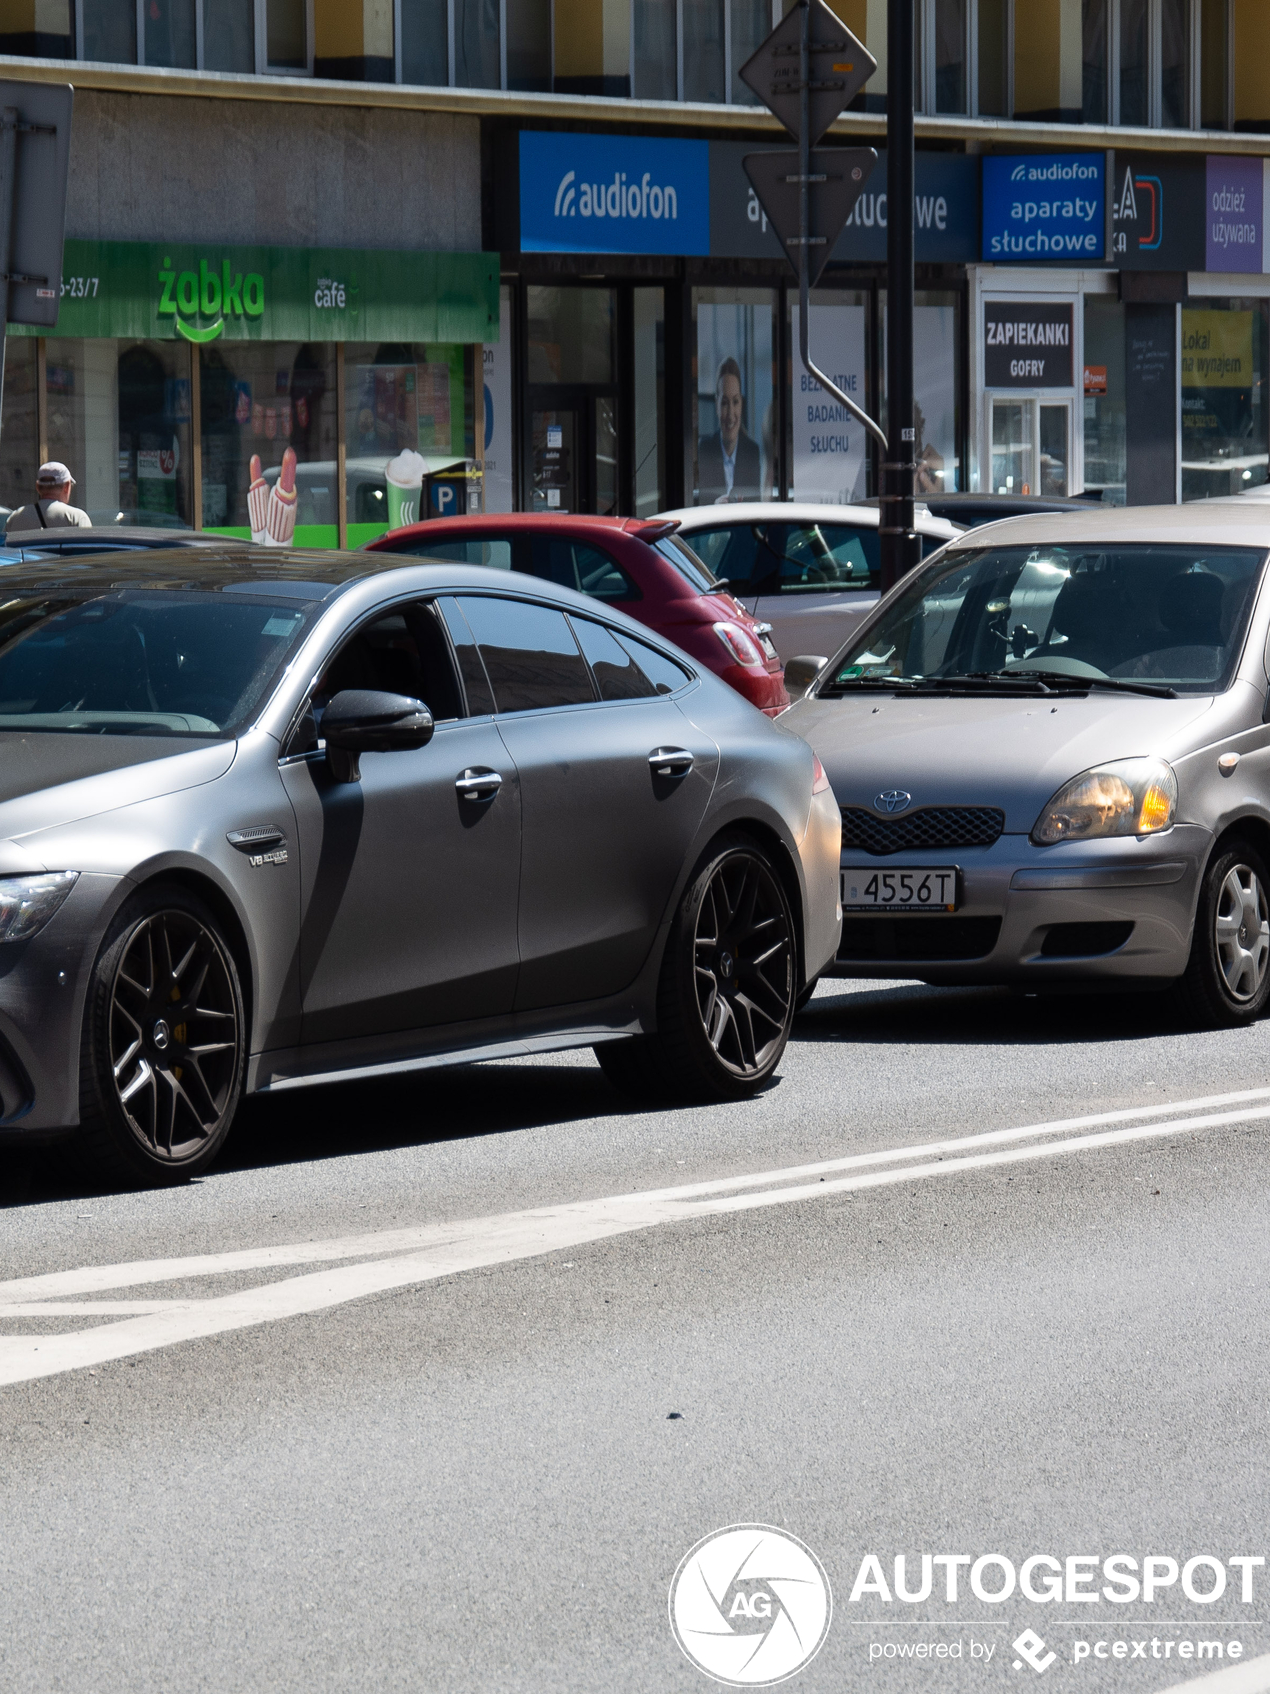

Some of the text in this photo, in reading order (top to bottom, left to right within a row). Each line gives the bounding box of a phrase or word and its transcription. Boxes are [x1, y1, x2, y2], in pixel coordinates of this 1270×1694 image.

[1028, 163, 1098, 181] audiofon
[580, 171, 678, 220] audiofon
[1212, 185, 1246, 213] odzież
[1010, 197, 1097, 222] aparaty
[990, 229, 1097, 253] słuchowe
[1212, 217, 1256, 247] używana
[157, 256, 264, 317] żabka
[986, 322, 1070, 345] ZAPIEKANKI
[1183, 330, 1210, 350] Lokal
[1010, 359, 1045, 377] GOFRY
[1197, 353, 1241, 378] wynajem
[810, 435, 849, 453] SŁUCHU
[864, 873, 951, 903] 4556T
